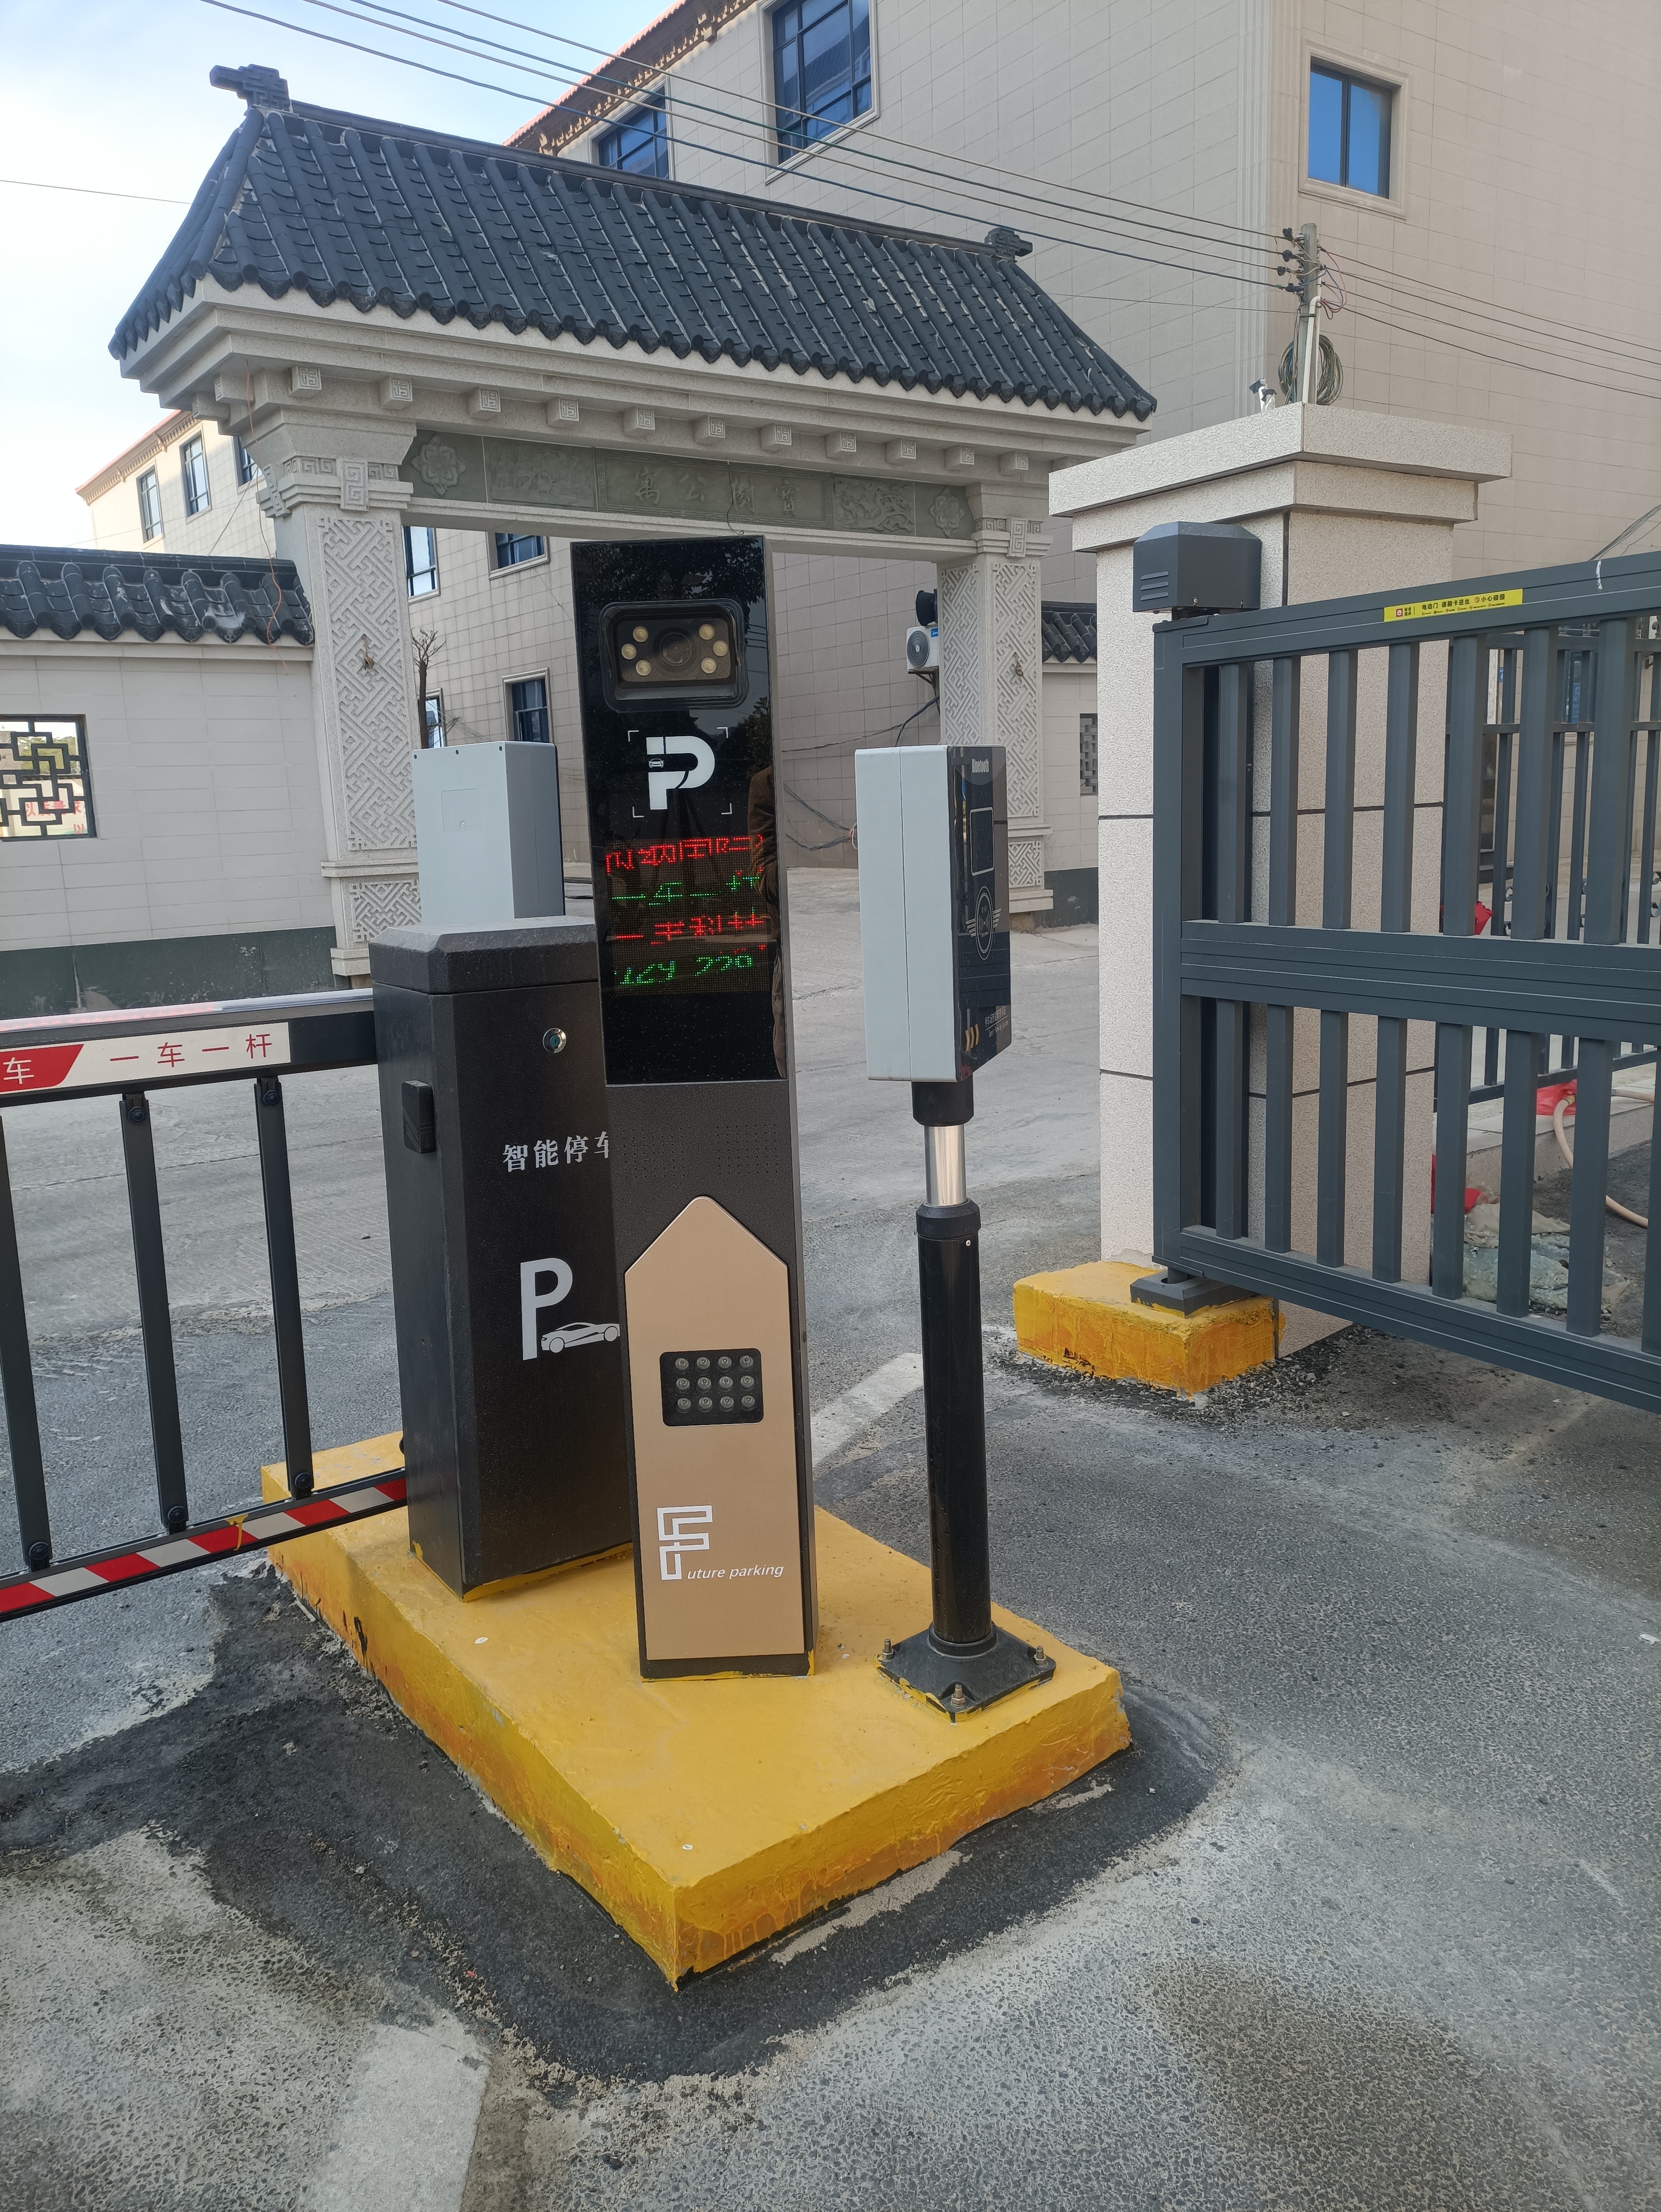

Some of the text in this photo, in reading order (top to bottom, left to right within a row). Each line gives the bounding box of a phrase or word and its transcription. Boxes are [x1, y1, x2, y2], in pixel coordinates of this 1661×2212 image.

[972, 758, 989, 773] Bluetooth
[110, 1033, 273, 1068] 一车一杆
[729, 1564, 784, 1580] parking
